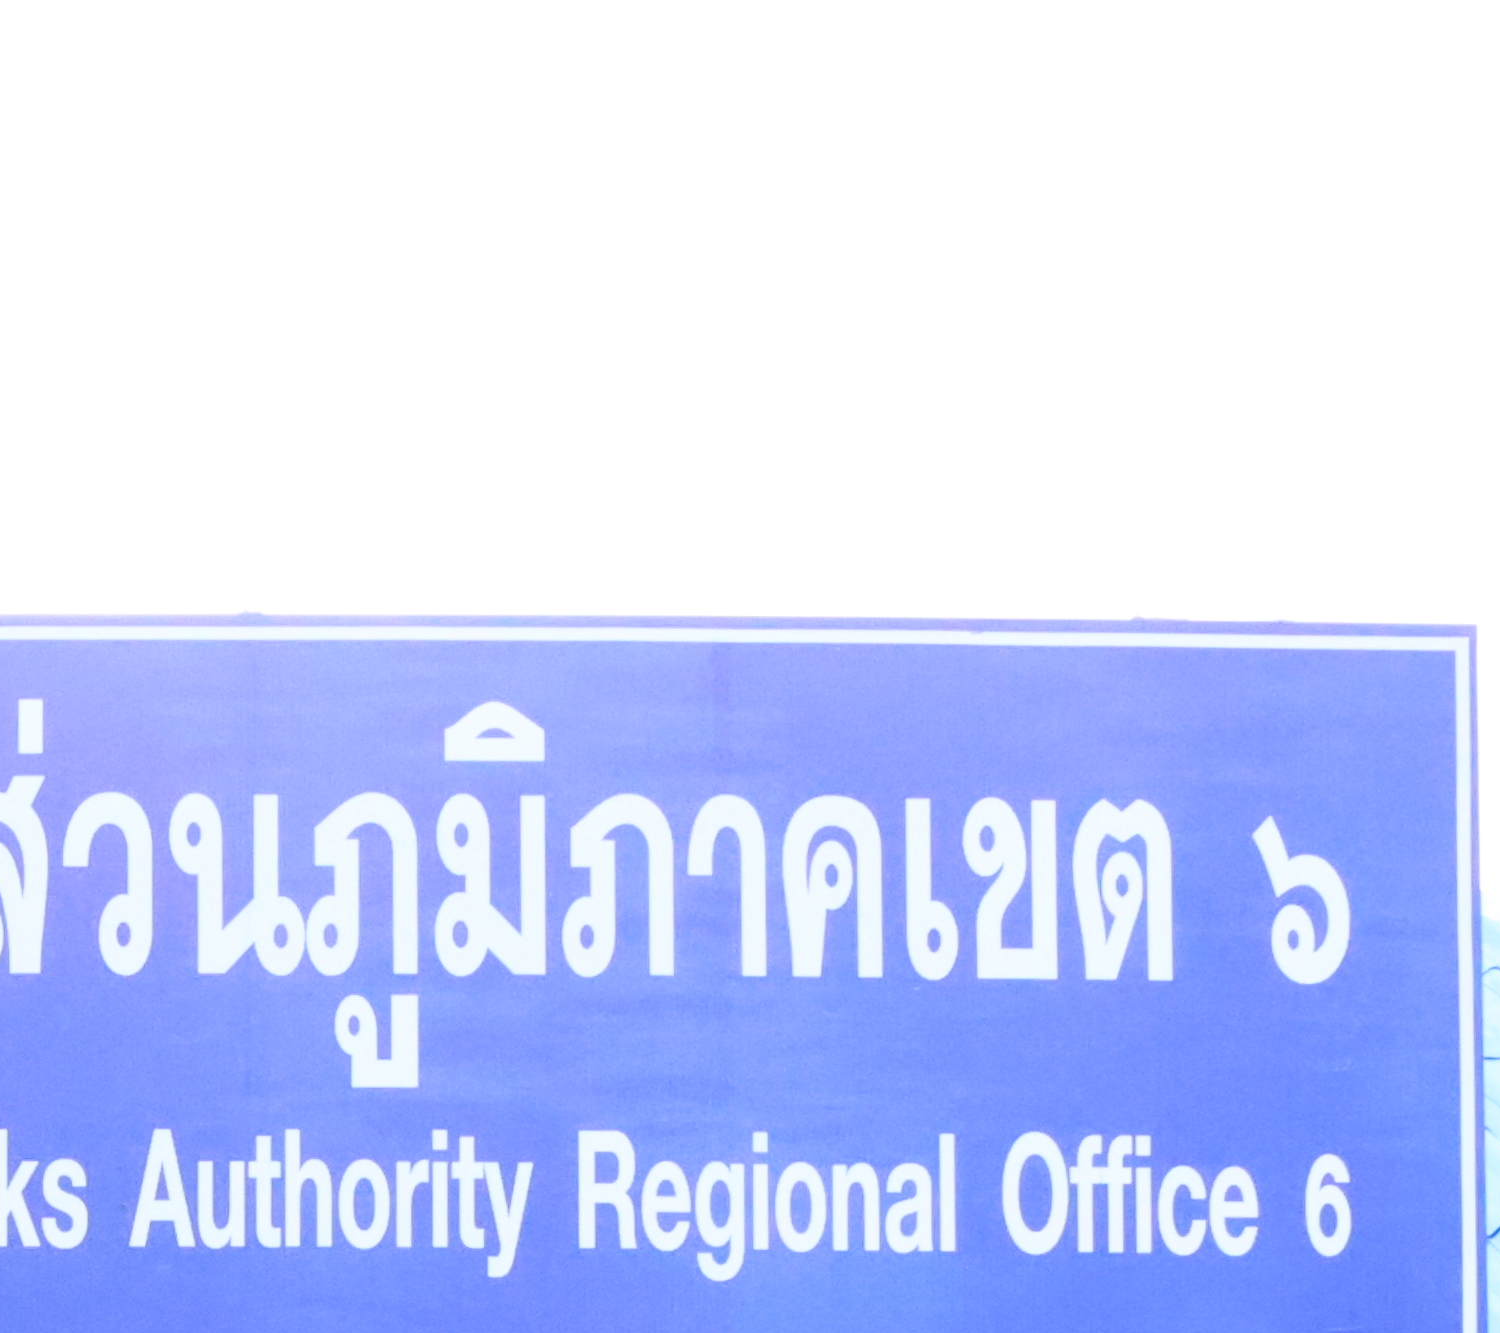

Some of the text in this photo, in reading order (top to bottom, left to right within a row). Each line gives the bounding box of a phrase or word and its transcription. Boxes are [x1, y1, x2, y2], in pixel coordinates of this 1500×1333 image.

[1252, 815, 1351, 985] ๖
[129, 1128, 534, 1277] Authority
[578, 1130, 957, 1281] Regional
[1001, 1132, 1260, 1257] Office
[1304, 1154, 1352, 1257] 6
